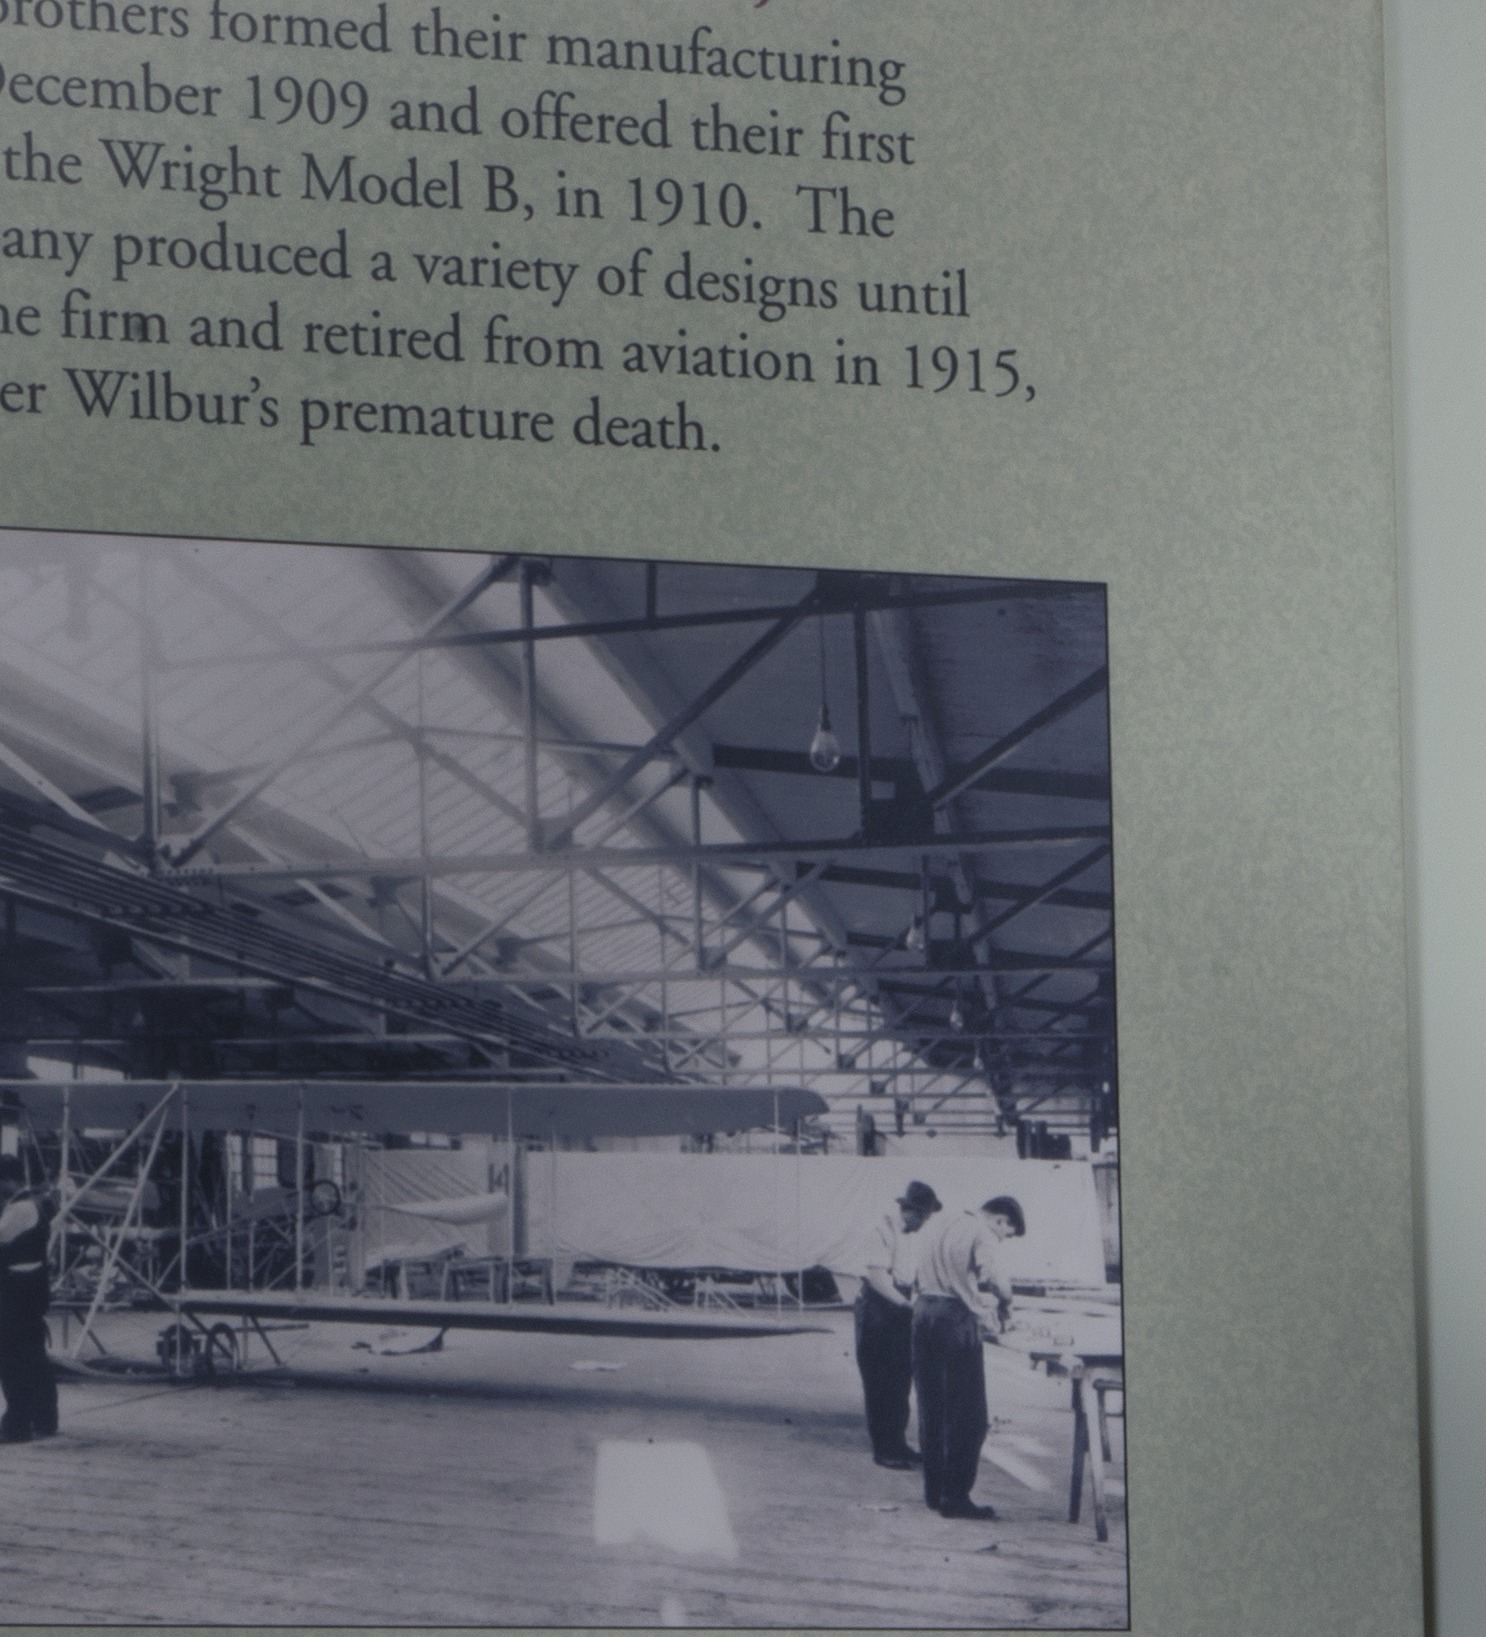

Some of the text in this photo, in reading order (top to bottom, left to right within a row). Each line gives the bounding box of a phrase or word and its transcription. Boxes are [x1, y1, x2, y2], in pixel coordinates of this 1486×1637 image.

[210, 0, 392, 53] formed
[412, 6, 527, 62] their
[547, 26, 906, 106] manufacturing
[0, 62, 915, 165] ecember 1909 and offered their first
[3, 130, 894, 238] the Wright Model B, in 1910. The
[113, 220, 352, 282] produced
[371, 251, 397, 282] a
[413, 241, 580, 307] variety
[597, 247, 653, 297] of
[665, 250, 837, 323] designs
[858, 268, 970, 317] until
[61, 288, 170, 344] firm
[190, 300, 284, 351] and
[304, 310, 465, 362] retired
[484, 314, 603, 370] from
[623, 328, 815, 382] aviation
[835, 338, 881, 386] in
[906, 345, 1035, 402] 1915,
[63, 368, 279, 427] Wilbur's
[300, 398, 554, 446] premature
[573, 396, 720, 452] death.
